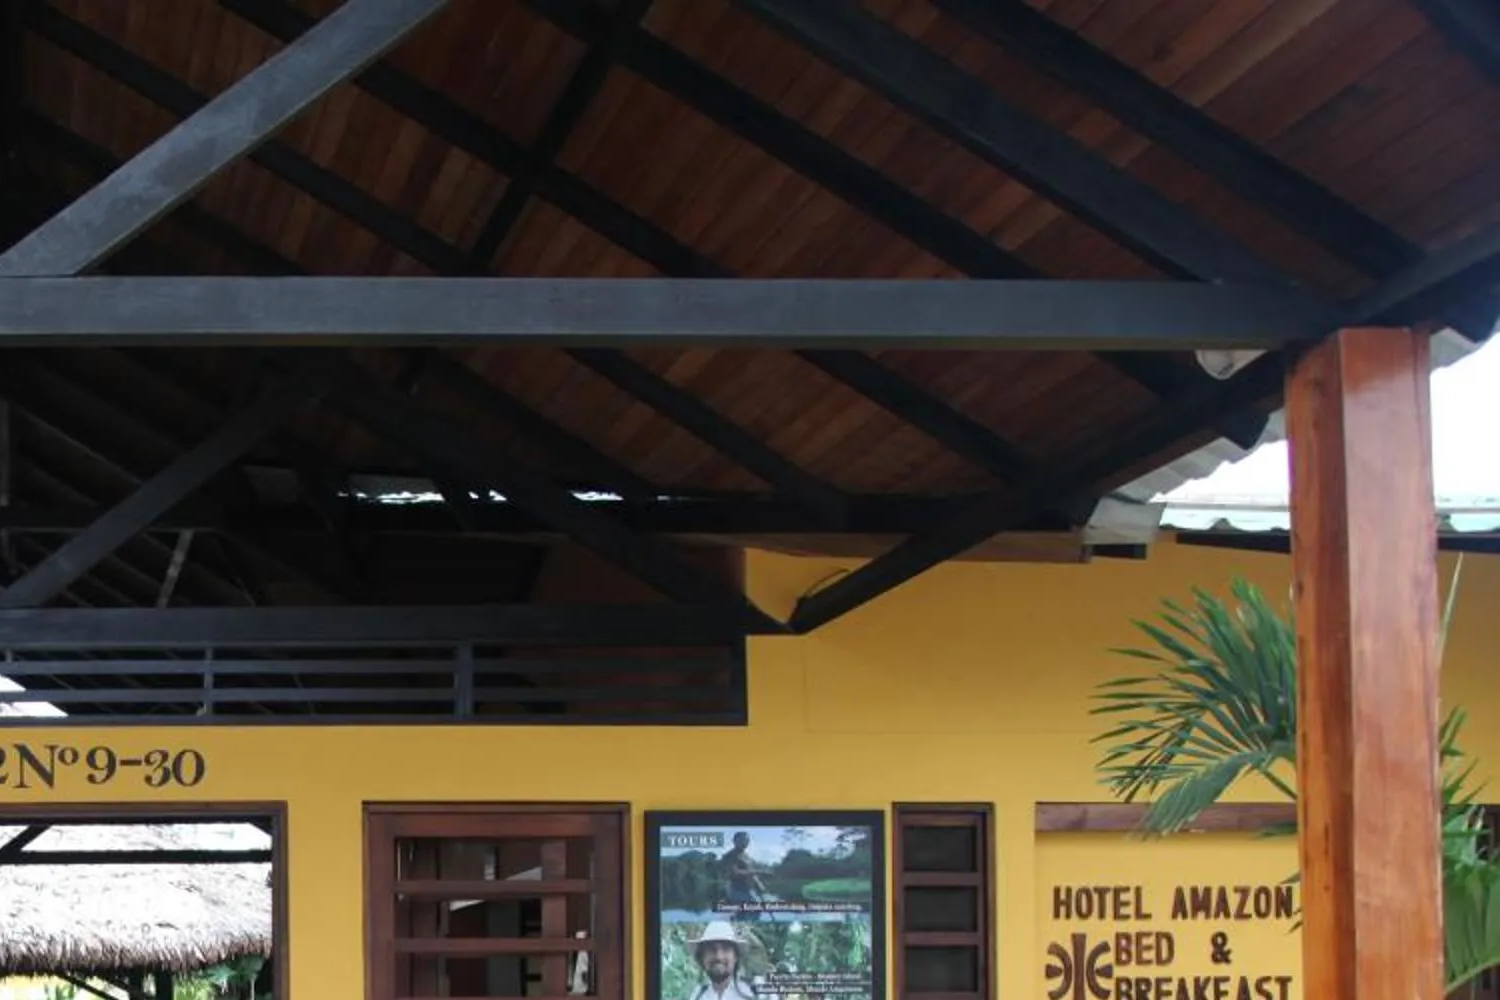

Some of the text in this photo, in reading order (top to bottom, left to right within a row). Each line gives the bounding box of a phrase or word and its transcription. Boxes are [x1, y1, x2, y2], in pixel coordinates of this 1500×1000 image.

[668, 834, 719, 847] TOURS
[1052, 884, 1295, 921] HOTEL AMAZON
[1114, 930, 1233, 967] BED &
